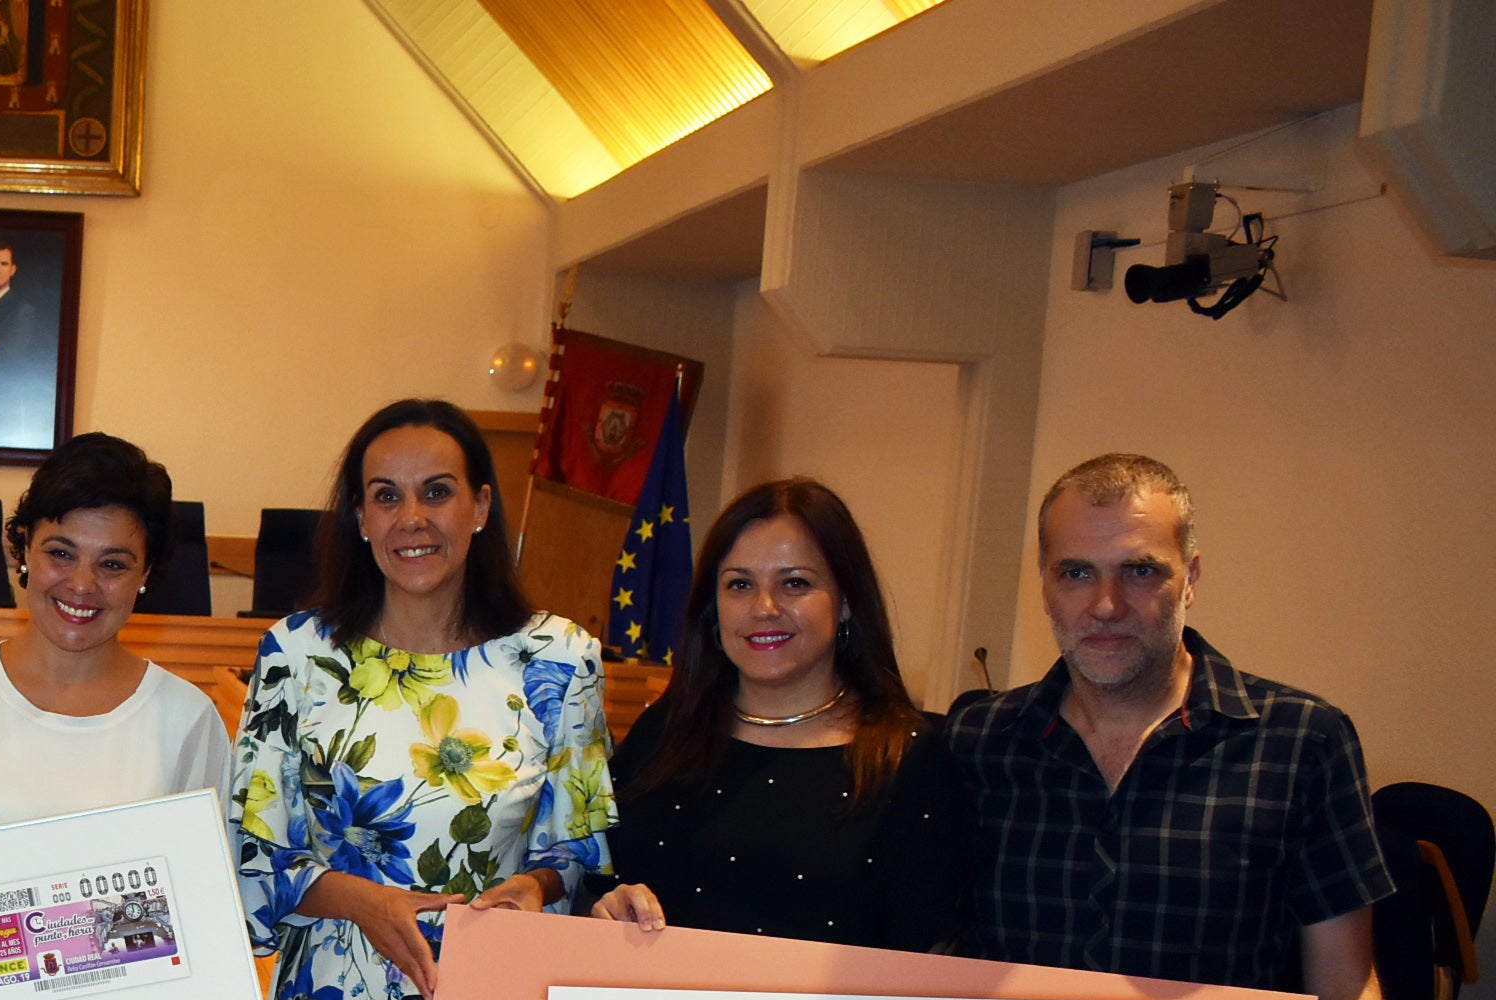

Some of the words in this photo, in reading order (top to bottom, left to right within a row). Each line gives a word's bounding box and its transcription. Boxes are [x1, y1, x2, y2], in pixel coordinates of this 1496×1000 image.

[51, 883, 68, 891] SERIE
[25, 911, 87, 934] Ciudades
[34, 931, 63, 946] punto
[68, 926, 93, 937] hora
[20, 972, 31, 981] 19
